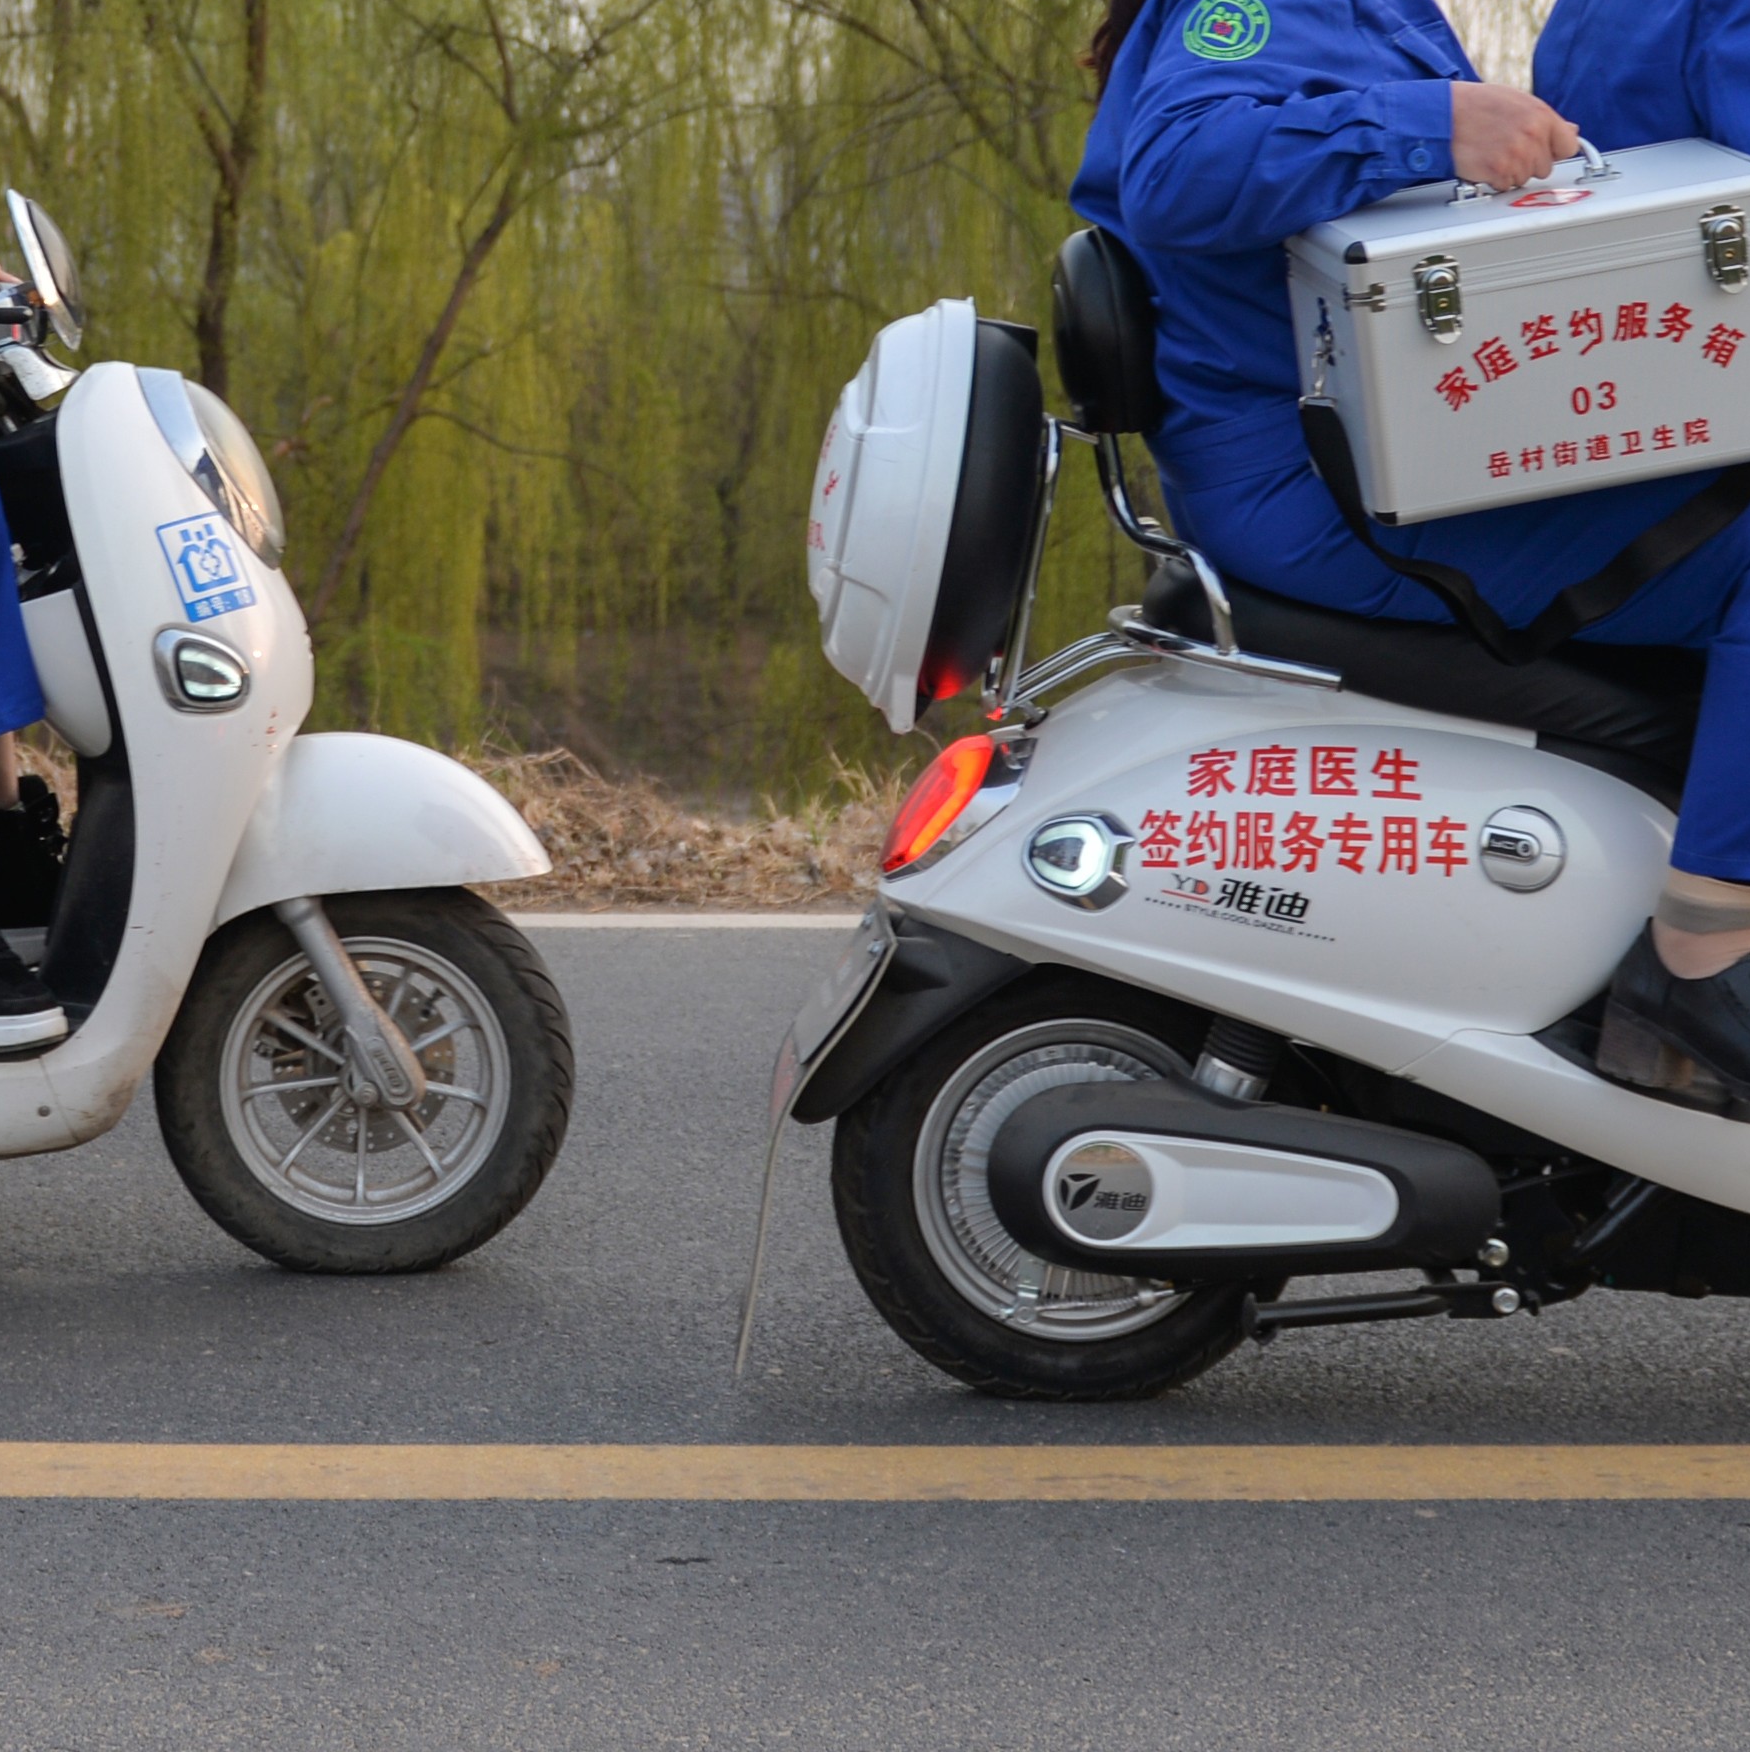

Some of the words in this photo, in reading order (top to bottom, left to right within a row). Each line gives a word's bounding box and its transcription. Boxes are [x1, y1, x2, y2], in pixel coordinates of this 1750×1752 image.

[1434, 301, 1746, 413] 家庭签约服务箱
[1570, 380, 1618, 416] 03
[1486, 417, 1711, 479] 岳村街道卫生院
[1187, 744, 1423, 802] 家庭医生
[1138, 808, 1470, 878] 签约服务专用车
[1213, 877, 1311, 925] 雅迪
[1093, 1191, 1147, 1212] 雅迪
